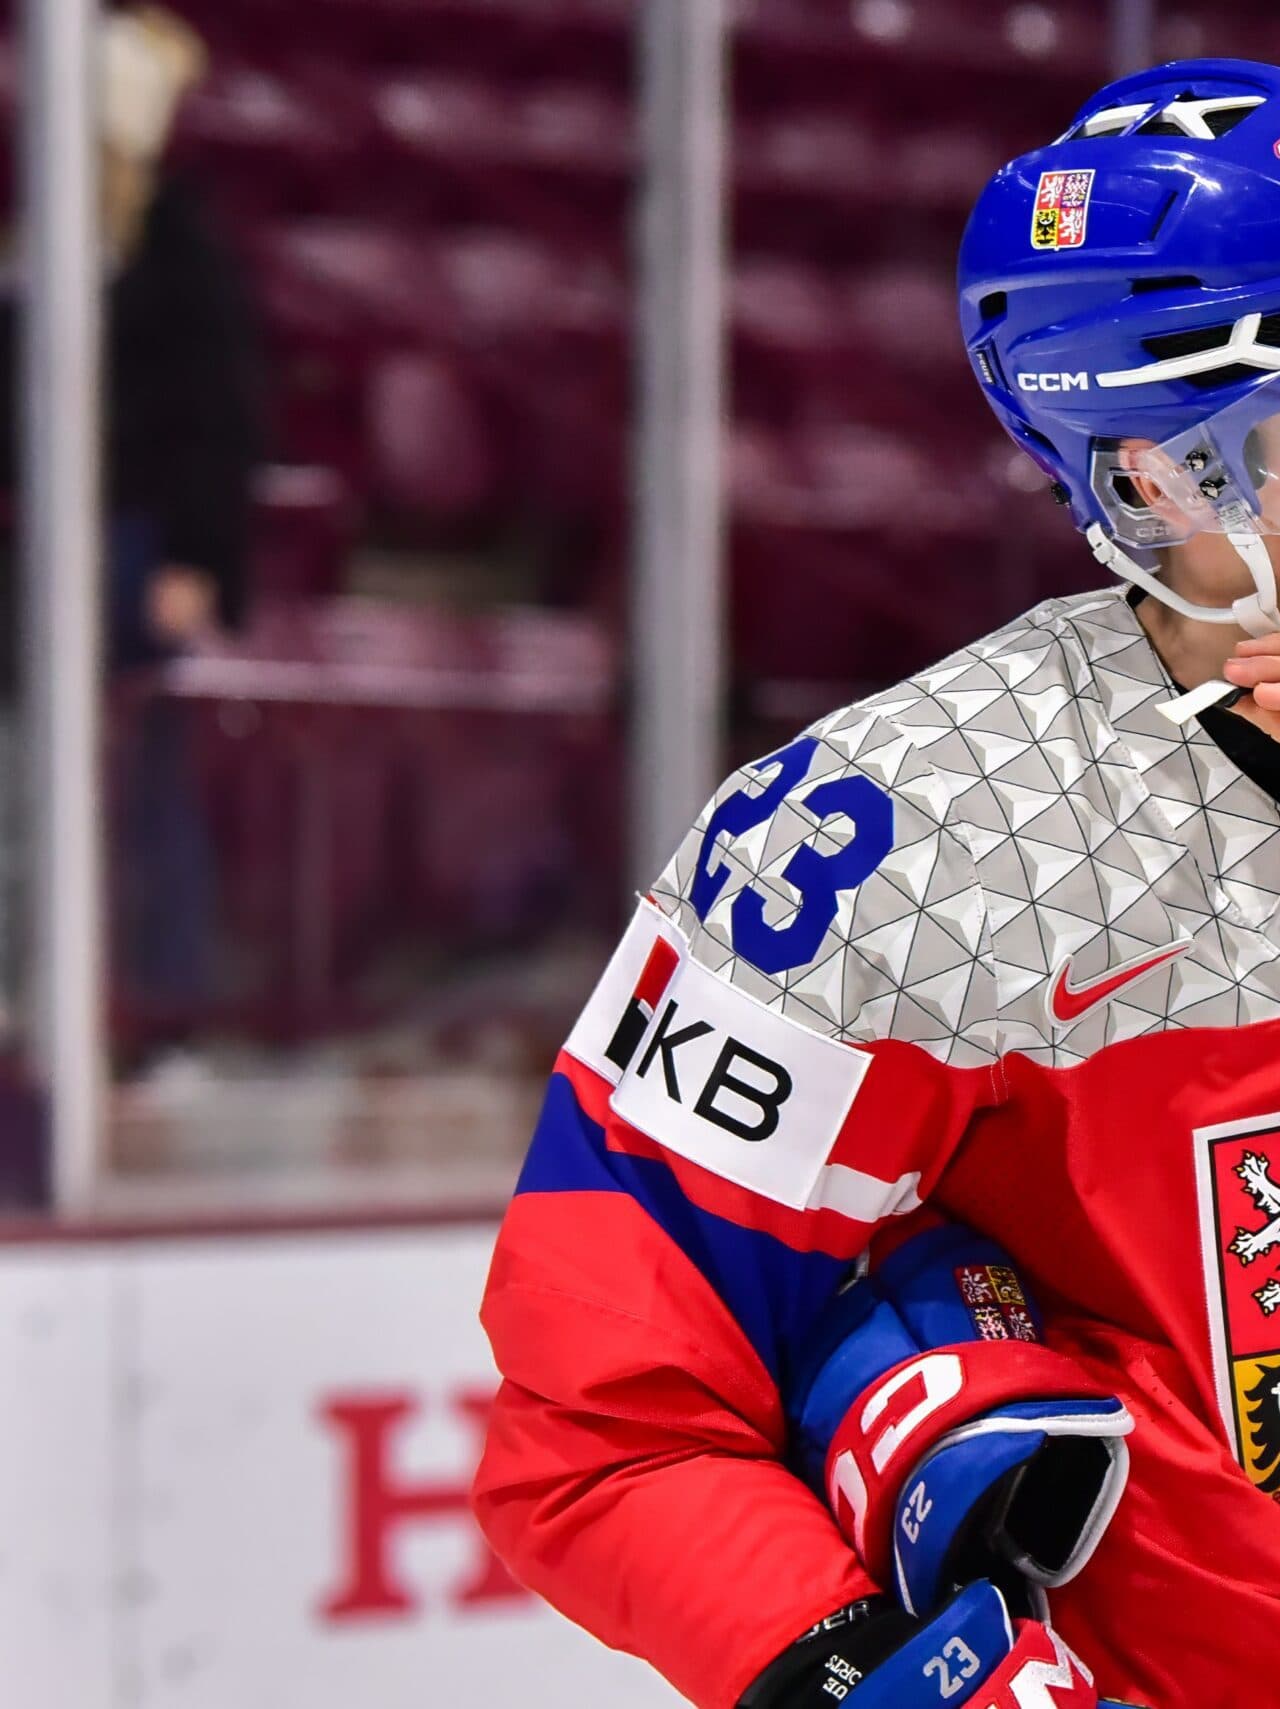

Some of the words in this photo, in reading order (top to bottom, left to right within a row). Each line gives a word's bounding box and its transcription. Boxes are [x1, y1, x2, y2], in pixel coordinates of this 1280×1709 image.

[1017, 371, 1089, 391] CCM
[689, 736, 894, 975] 23
[636, 998, 793, 1142] KB
[901, 1480, 933, 1545] 23
[922, 1636, 981, 1699] 23
